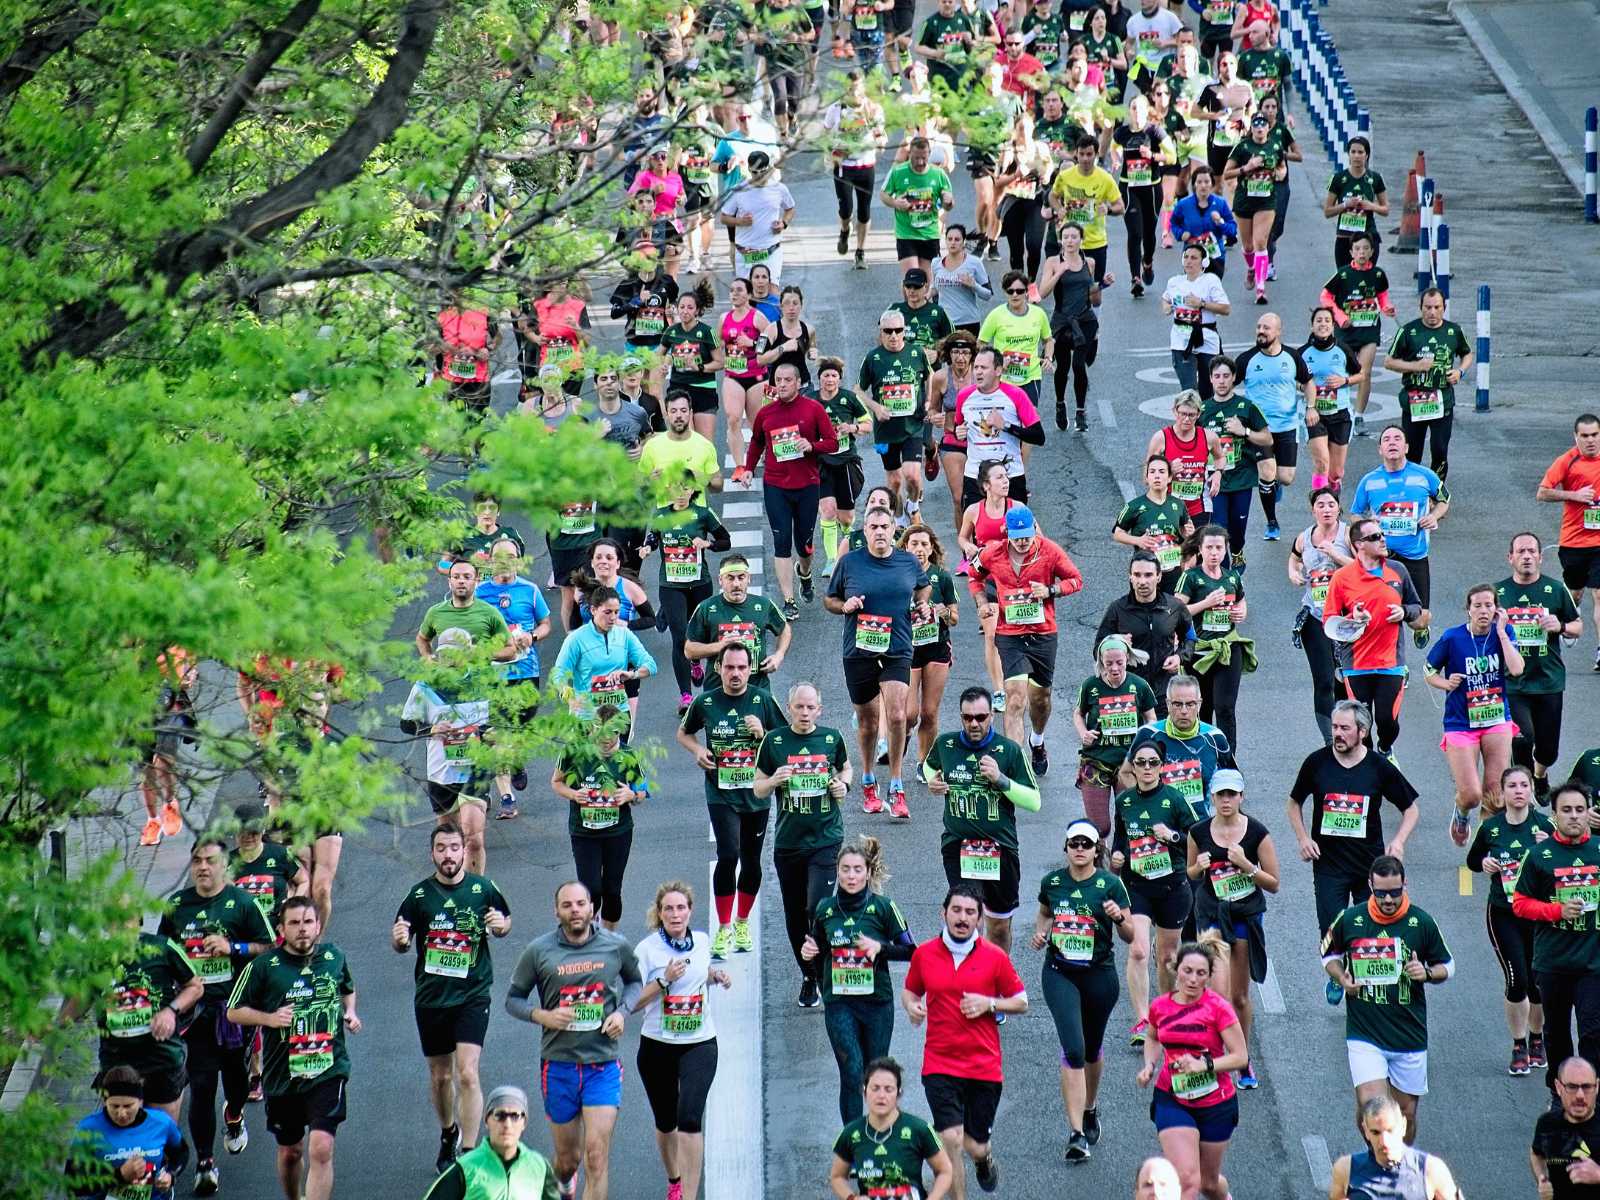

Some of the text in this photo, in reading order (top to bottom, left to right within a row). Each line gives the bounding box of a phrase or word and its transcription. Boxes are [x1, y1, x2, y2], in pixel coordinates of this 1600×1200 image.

[1015, 607, 1034, 617] 43163
[1467, 671, 1500, 685] FOR THE
[730, 771, 750, 783] 42804
[948, 772, 973, 780] MADRID
[801, 779, 821, 789] 41756
[1334, 817, 1355, 829] 42572
[439, 955, 462, 967] 42859
[201, 963, 223, 975] 42384
[1366, 963, 1389, 976] 42659
[285, 989, 314, 999] MADRID
